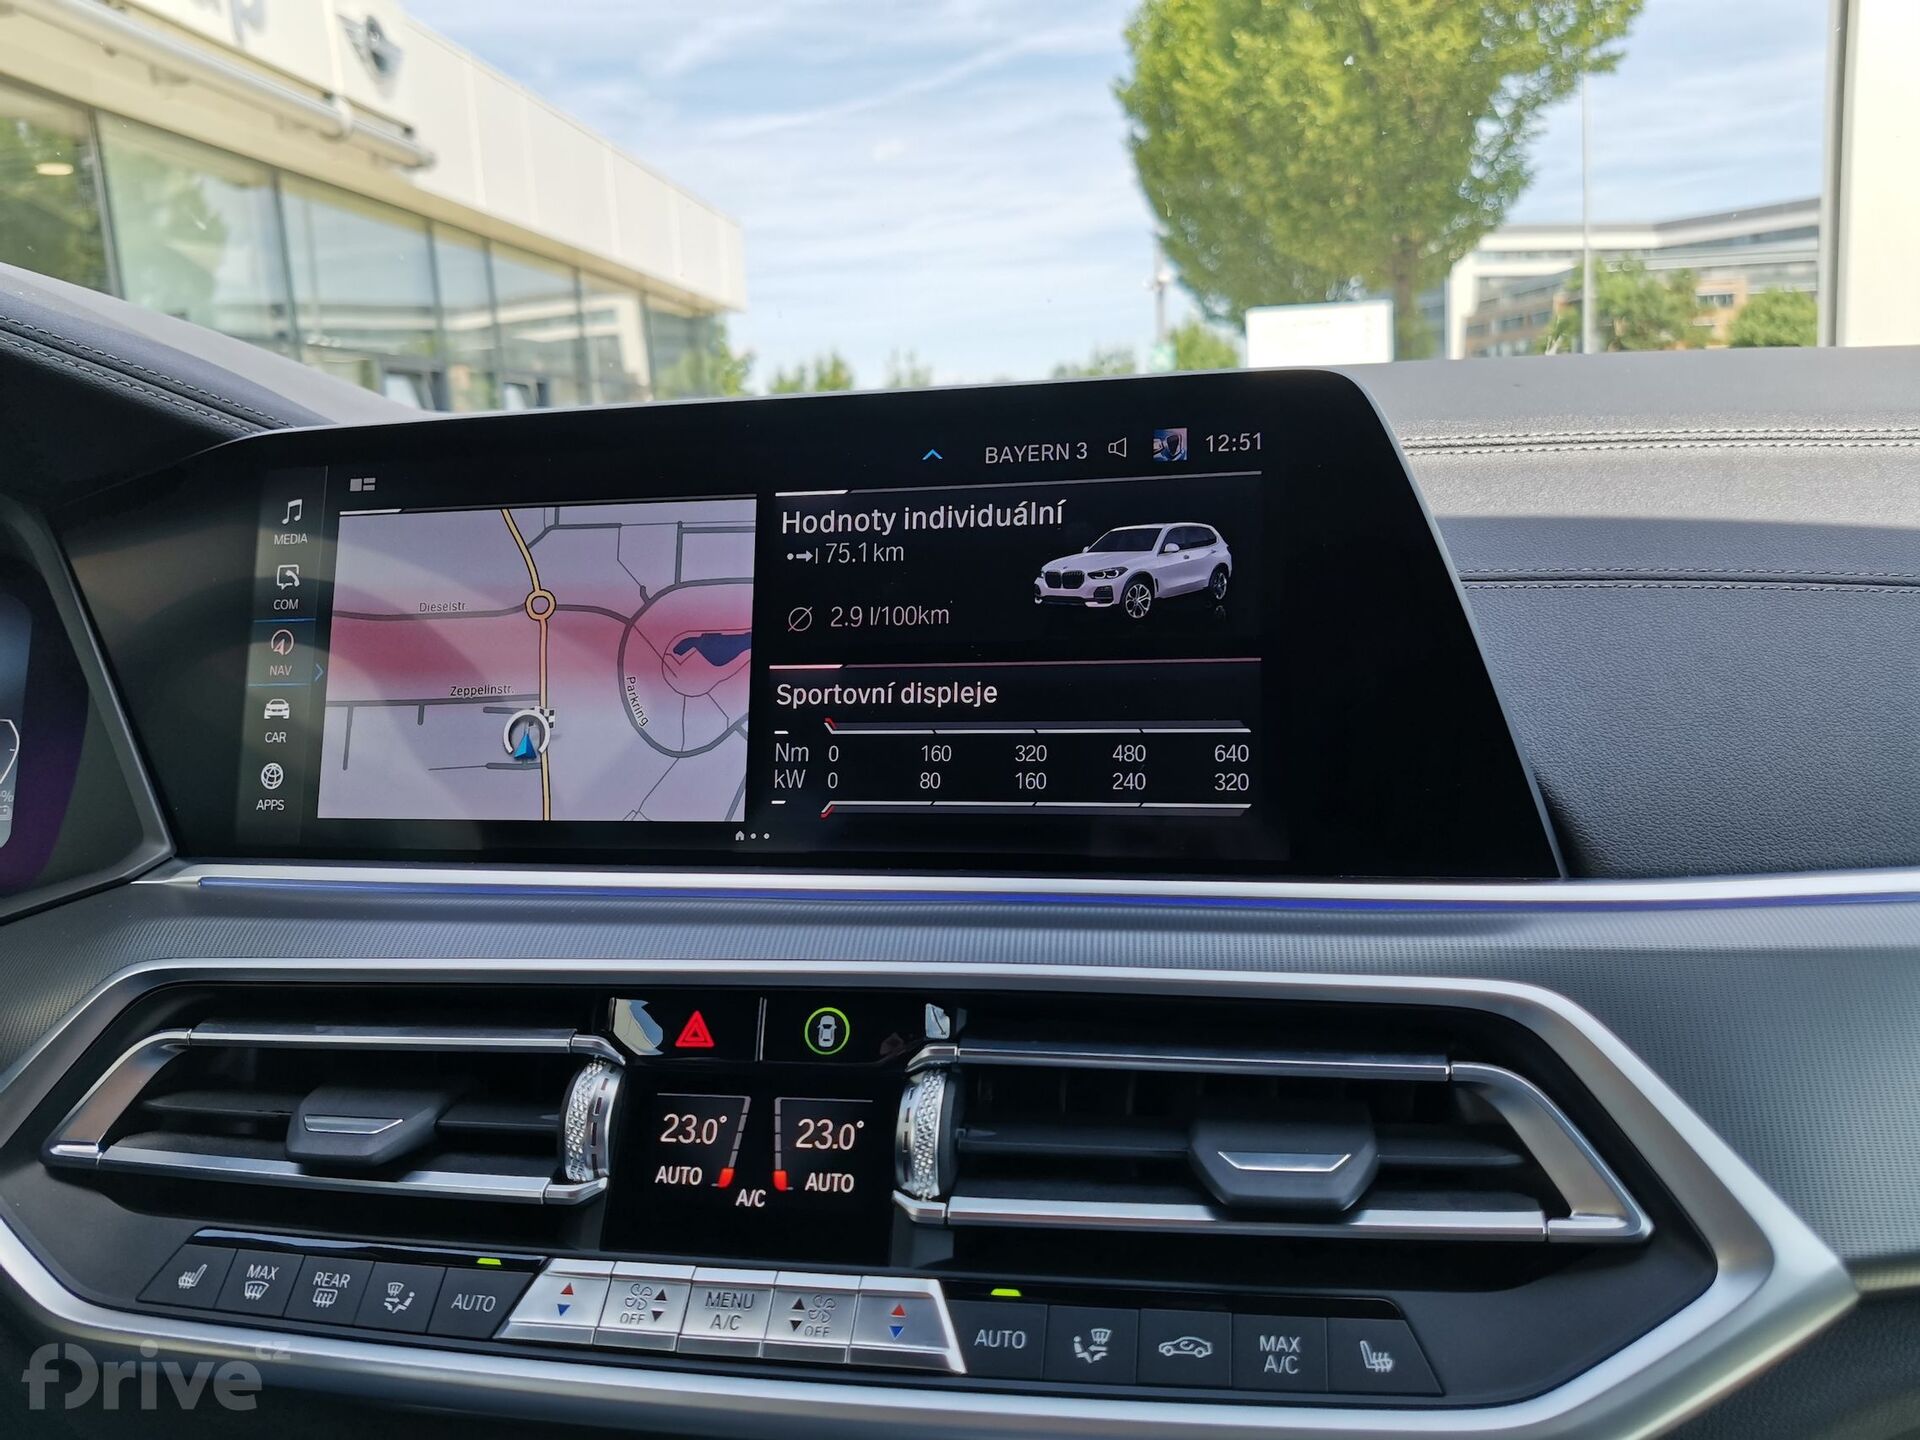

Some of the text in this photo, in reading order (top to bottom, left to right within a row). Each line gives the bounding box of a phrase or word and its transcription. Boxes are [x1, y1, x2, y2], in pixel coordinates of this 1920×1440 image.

[1205, 431, 1262, 453] 12:51
[985, 442, 1088, 464] BAYERN 3
[782, 500, 1067, 537] Hodnoty individuální
[273, 533, 308, 545] MEDIA
[825, 543, 904, 564] 75.1 km
[273, 598, 299, 611] COM
[419, 600, 468, 613] Dieselstr.
[830, 606, 950, 627] 2.9 l/100km
[269, 664, 292, 677] NAV
[450, 682, 514, 697] Zeppelinstr.
[776, 681, 998, 708] Sportovní displeje
[626, 675, 649, 727] Parkring
[265, 731, 286, 743] CAR
[774, 744, 1249, 763] Nm 0 160 320 480 640
[774, 770, 1249, 792] kW 0 80 160 240 320
[256, 799, 285, 811] APPS
[655, 1166, 702, 1185] AUTO
[805, 1173, 854, 1192] AUTO
[736, 1189, 766, 1207] A/C
[246, 1264, 279, 1280] MAX
[313, 1272, 350, 1288] REAR
[450, 1293, 496, 1312] AUTO
[705, 1291, 755, 1310] MENU
[619, 1312, 645, 1325] OFF
[710, 1314, 740, 1331] A/C
[804, 1324, 830, 1338] OFF
[974, 1329, 1026, 1350] AUTO
[1260, 1335, 1300, 1353] MAX
[1264, 1354, 1299, 1375] A/C
